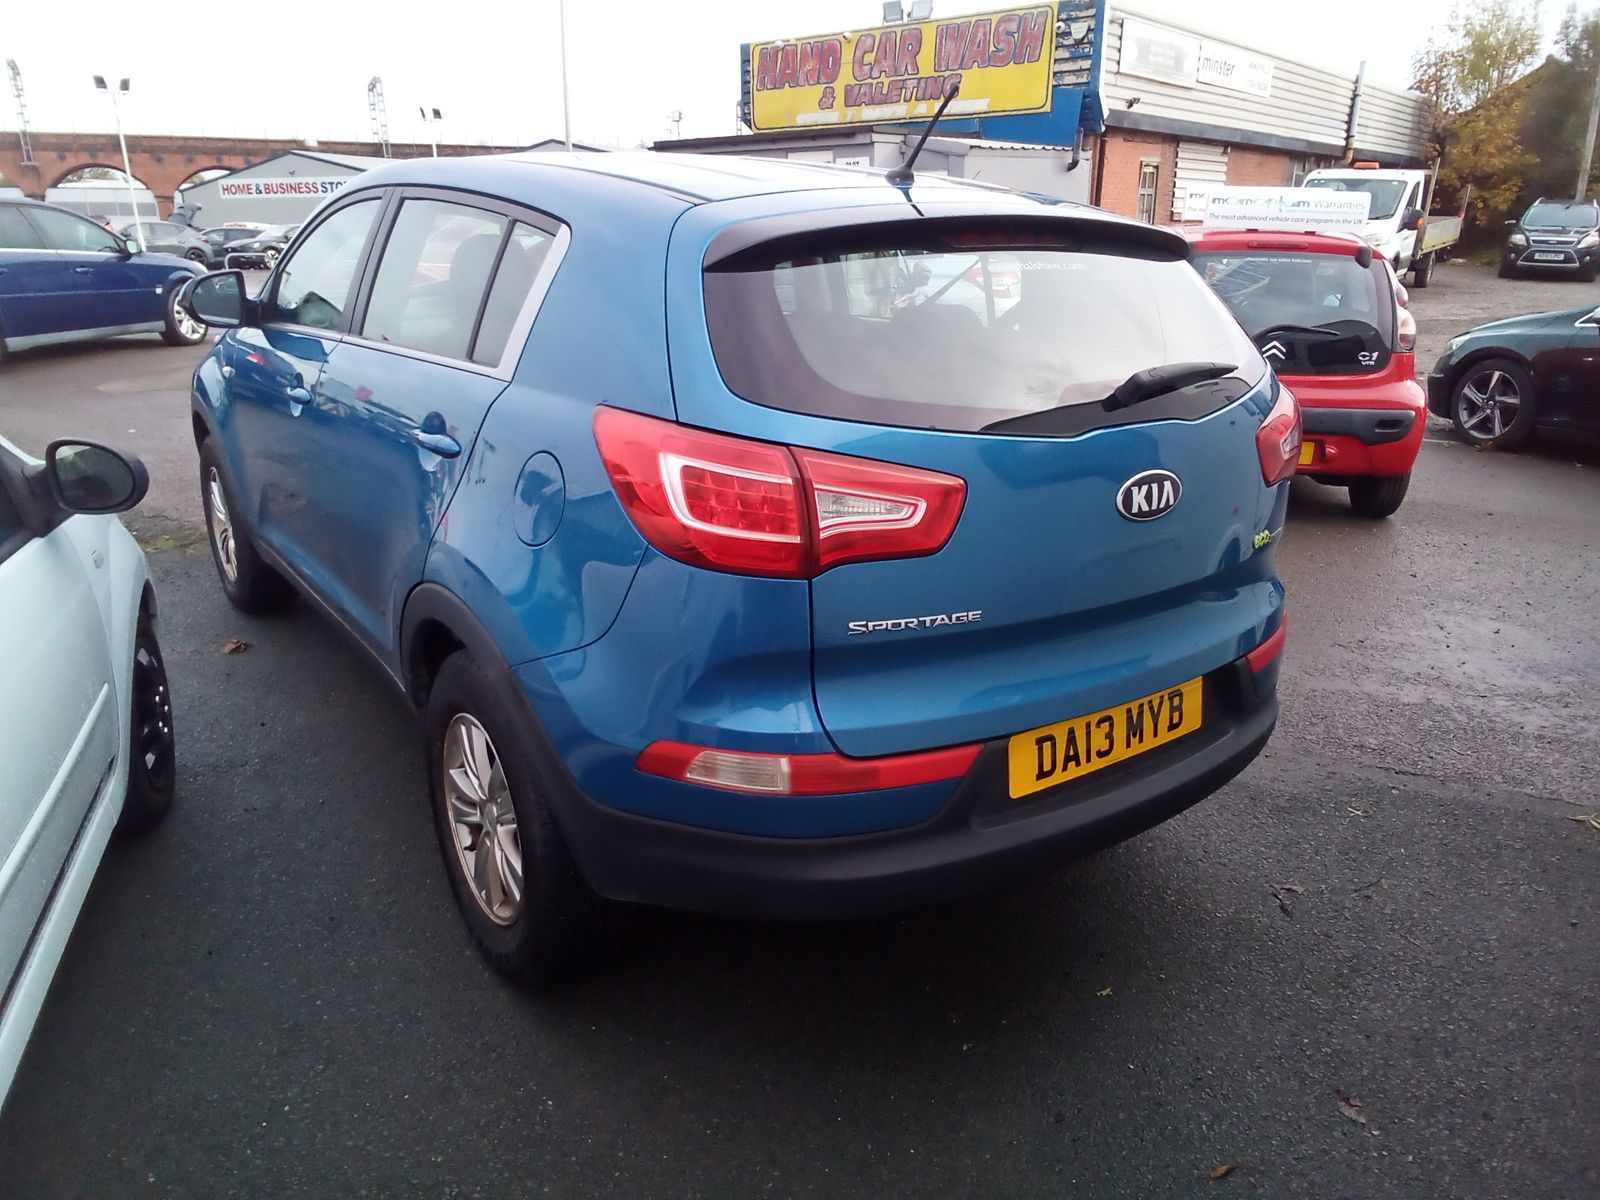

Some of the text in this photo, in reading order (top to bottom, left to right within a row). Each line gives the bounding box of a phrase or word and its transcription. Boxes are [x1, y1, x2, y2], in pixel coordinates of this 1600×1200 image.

[756, 11, 1048, 91] HAND CAR WASH
[1202, 56, 1236, 78] minster
[818, 73, 963, 110] & VALETING
[222, 184, 253, 195] HOME
[255, 183, 263, 195] &
[264, 182, 319, 194] BUSINESS
[1314, 199, 1366, 210] Warranties
[1236, 214, 1268, 222] advanced
[1268, 215, 1291, 223] vehicle
[1305, 217, 1335, 226] program
[1130, 480, 1177, 515] KIA
[848, 610, 982, 635] SPORTAGE
[1035, 688, 1184, 782] DA13 MYB
